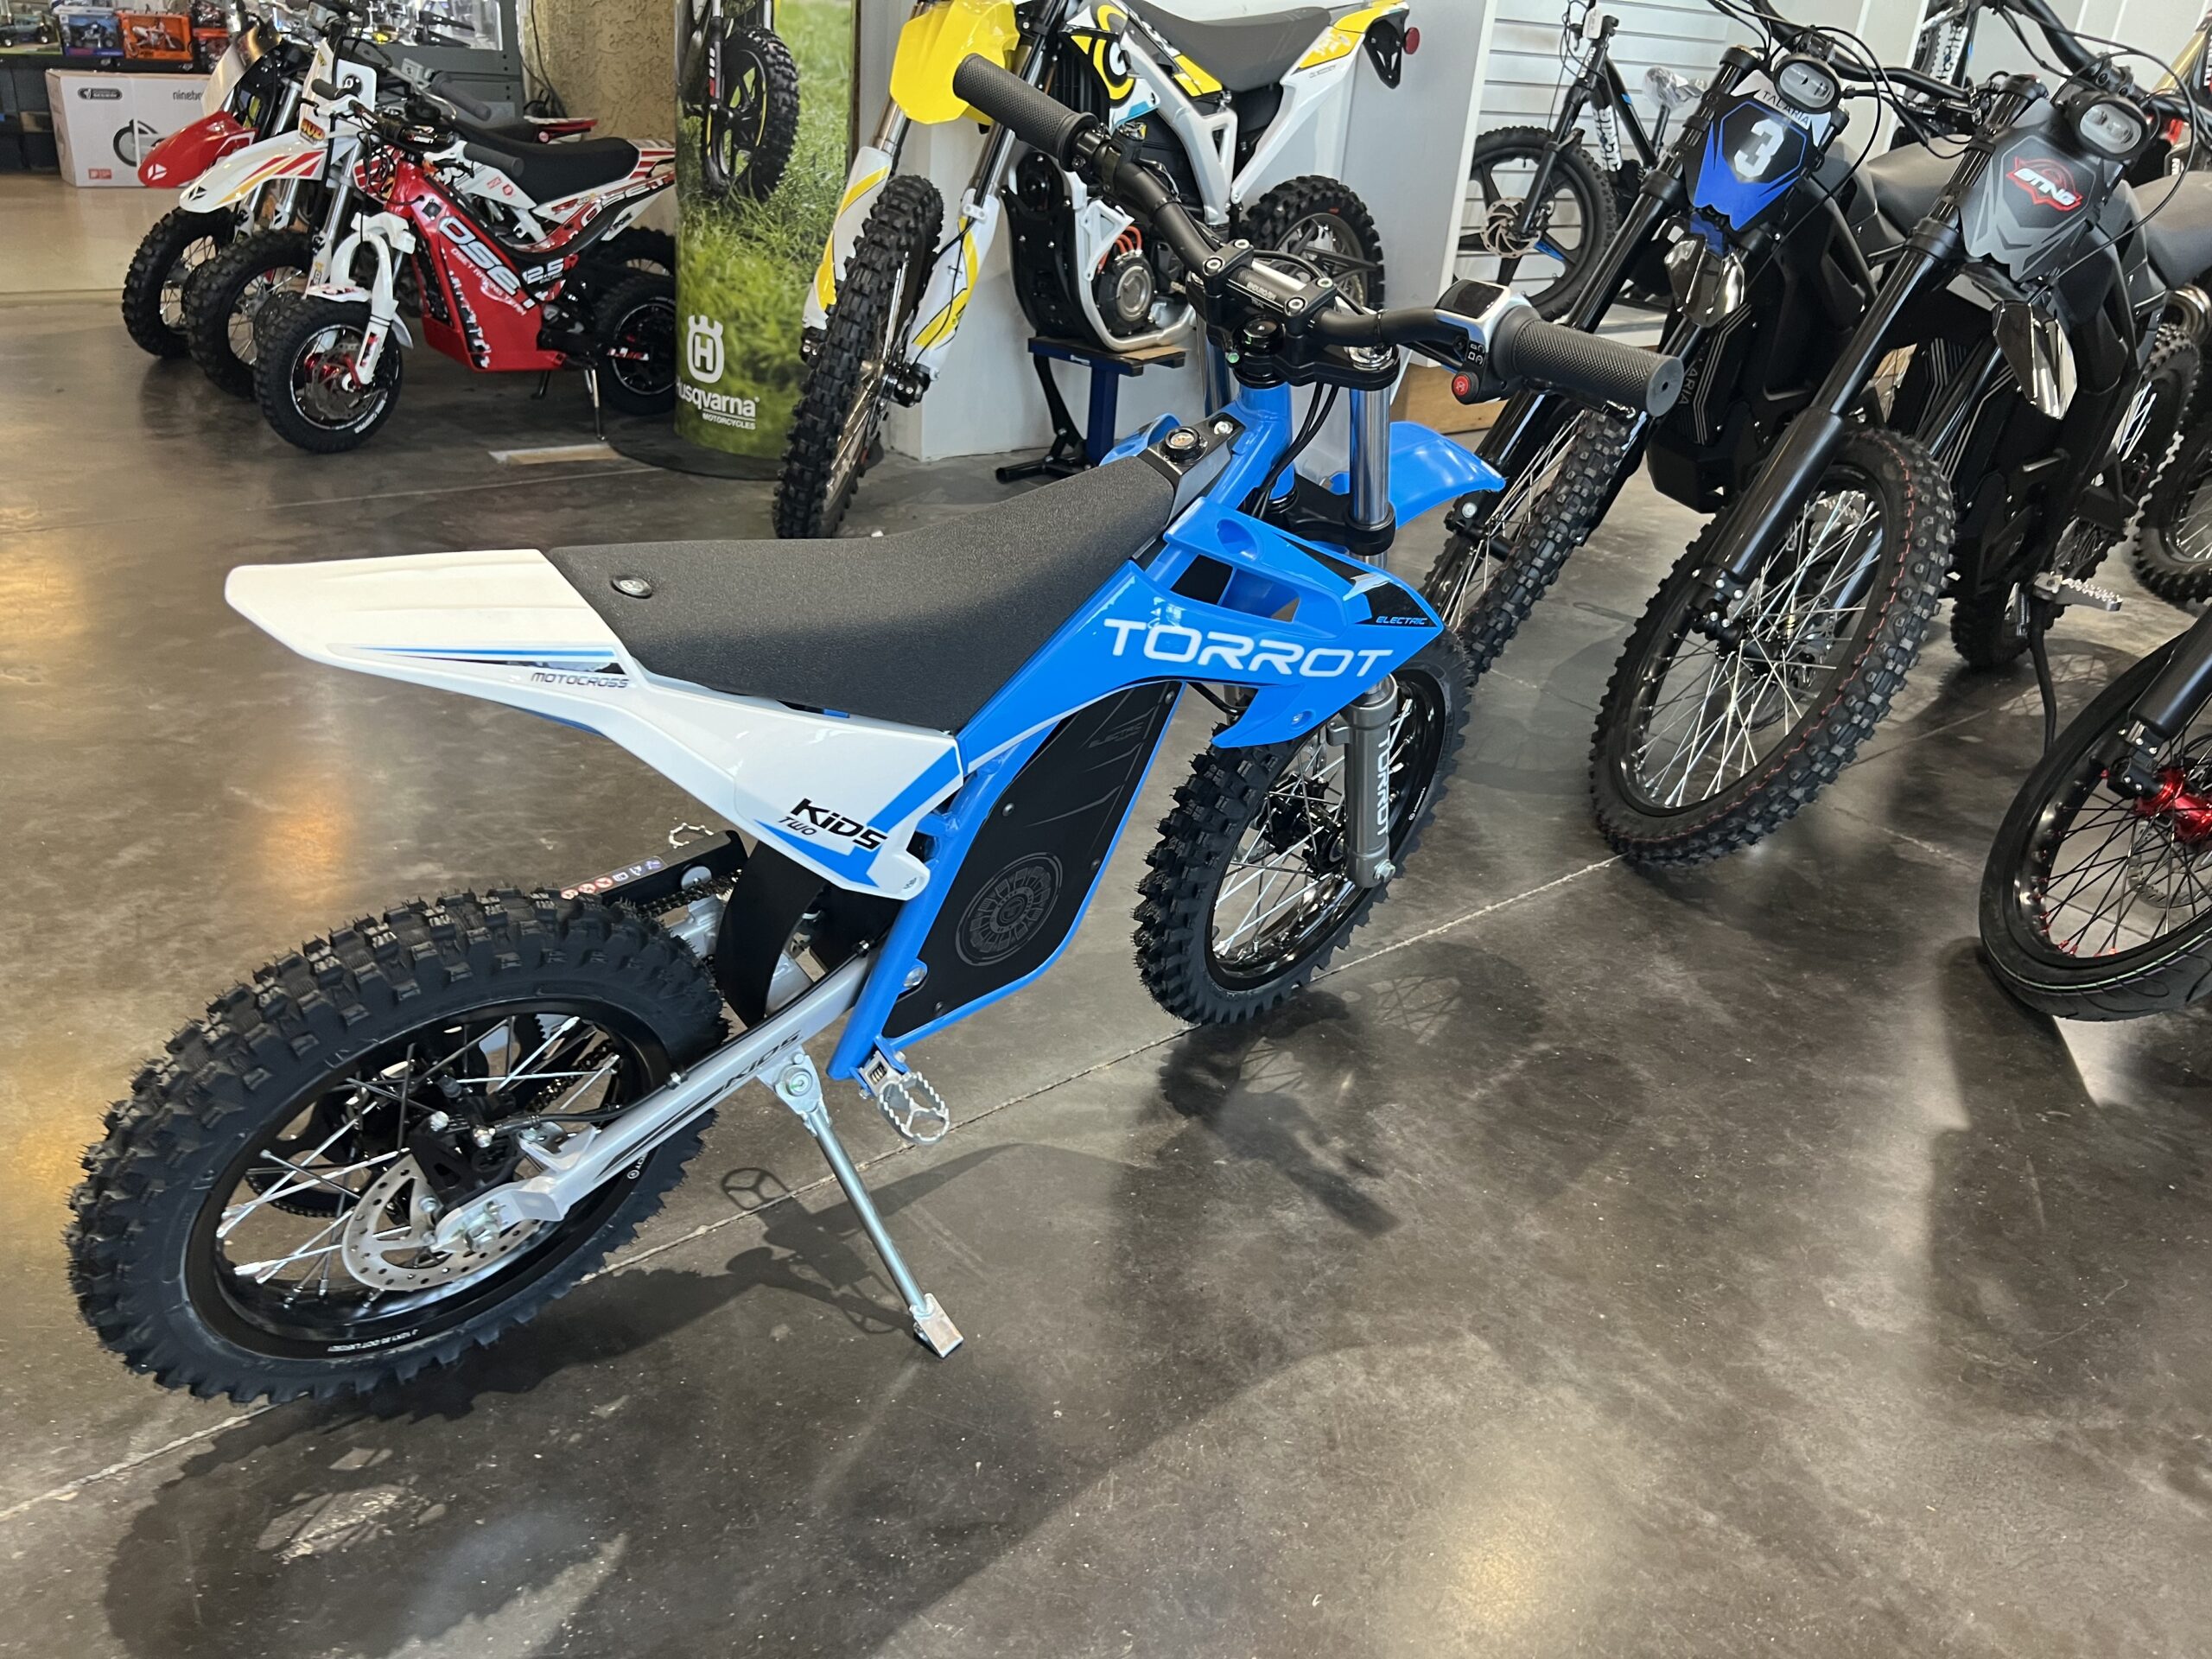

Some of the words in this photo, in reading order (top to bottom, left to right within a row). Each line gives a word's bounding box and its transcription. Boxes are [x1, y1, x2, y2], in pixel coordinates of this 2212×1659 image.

[1734, 118, 1784, 178] 3
[2013, 168, 2077, 206] STING
[702, 412, 756, 430] MOTORCYCLES
[1376, 615, 1428, 626] ELECTRIC
[1103, 618, 1395, 678] TORROT
[530, 671, 630, 689] MOTOCROSS
[1376, 728, 1390, 836] TORROT
[779, 816, 818, 836] TWO
